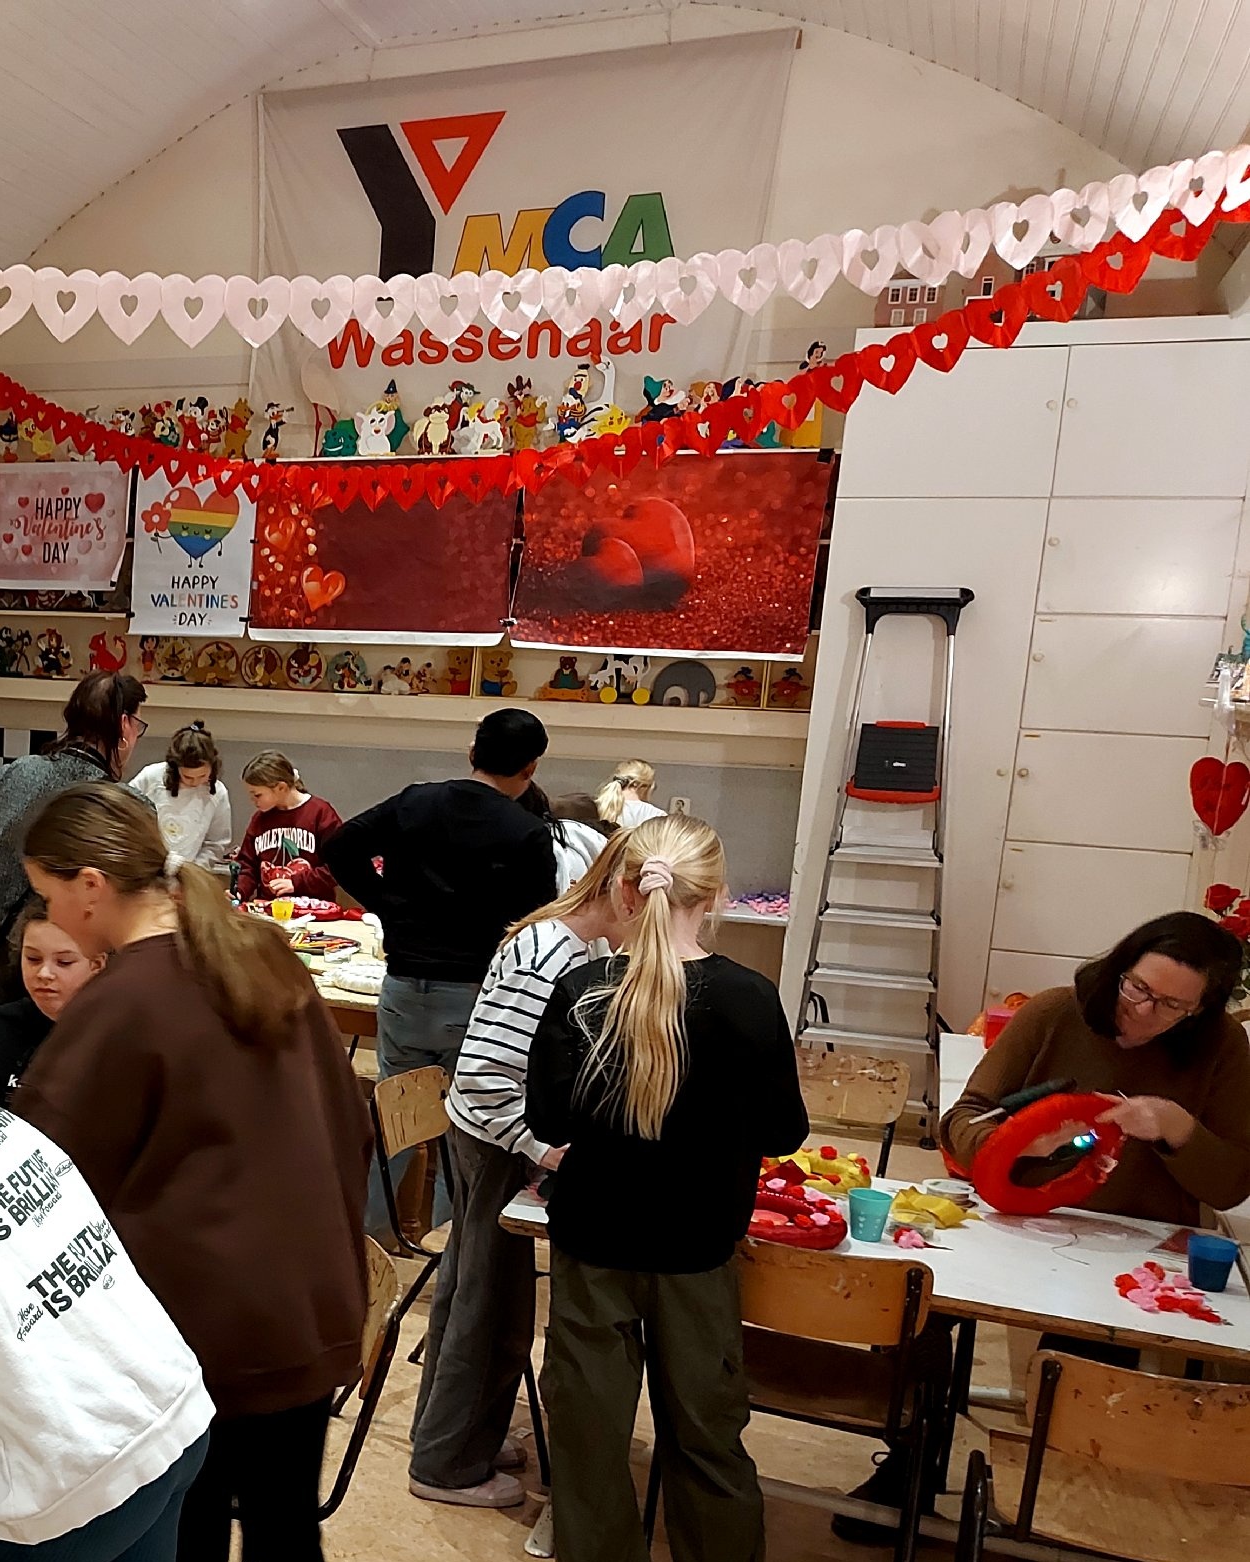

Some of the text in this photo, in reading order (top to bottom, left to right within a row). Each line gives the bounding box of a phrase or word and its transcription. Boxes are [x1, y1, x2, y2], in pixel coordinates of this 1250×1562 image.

[337, 111, 675, 281] YMCA
[328, 312, 678, 369] Wassenaar
[35, 497, 82, 520] HAPPY
[43, 542, 69, 564] DAY
[171, 575, 219, 589] HAPPY
[150, 593, 239, 609] VALENTINES
[178, 612, 208, 627] DAY
[26, 1251, 77, 1298] THE
[42, 1288, 72, 1319] IS
